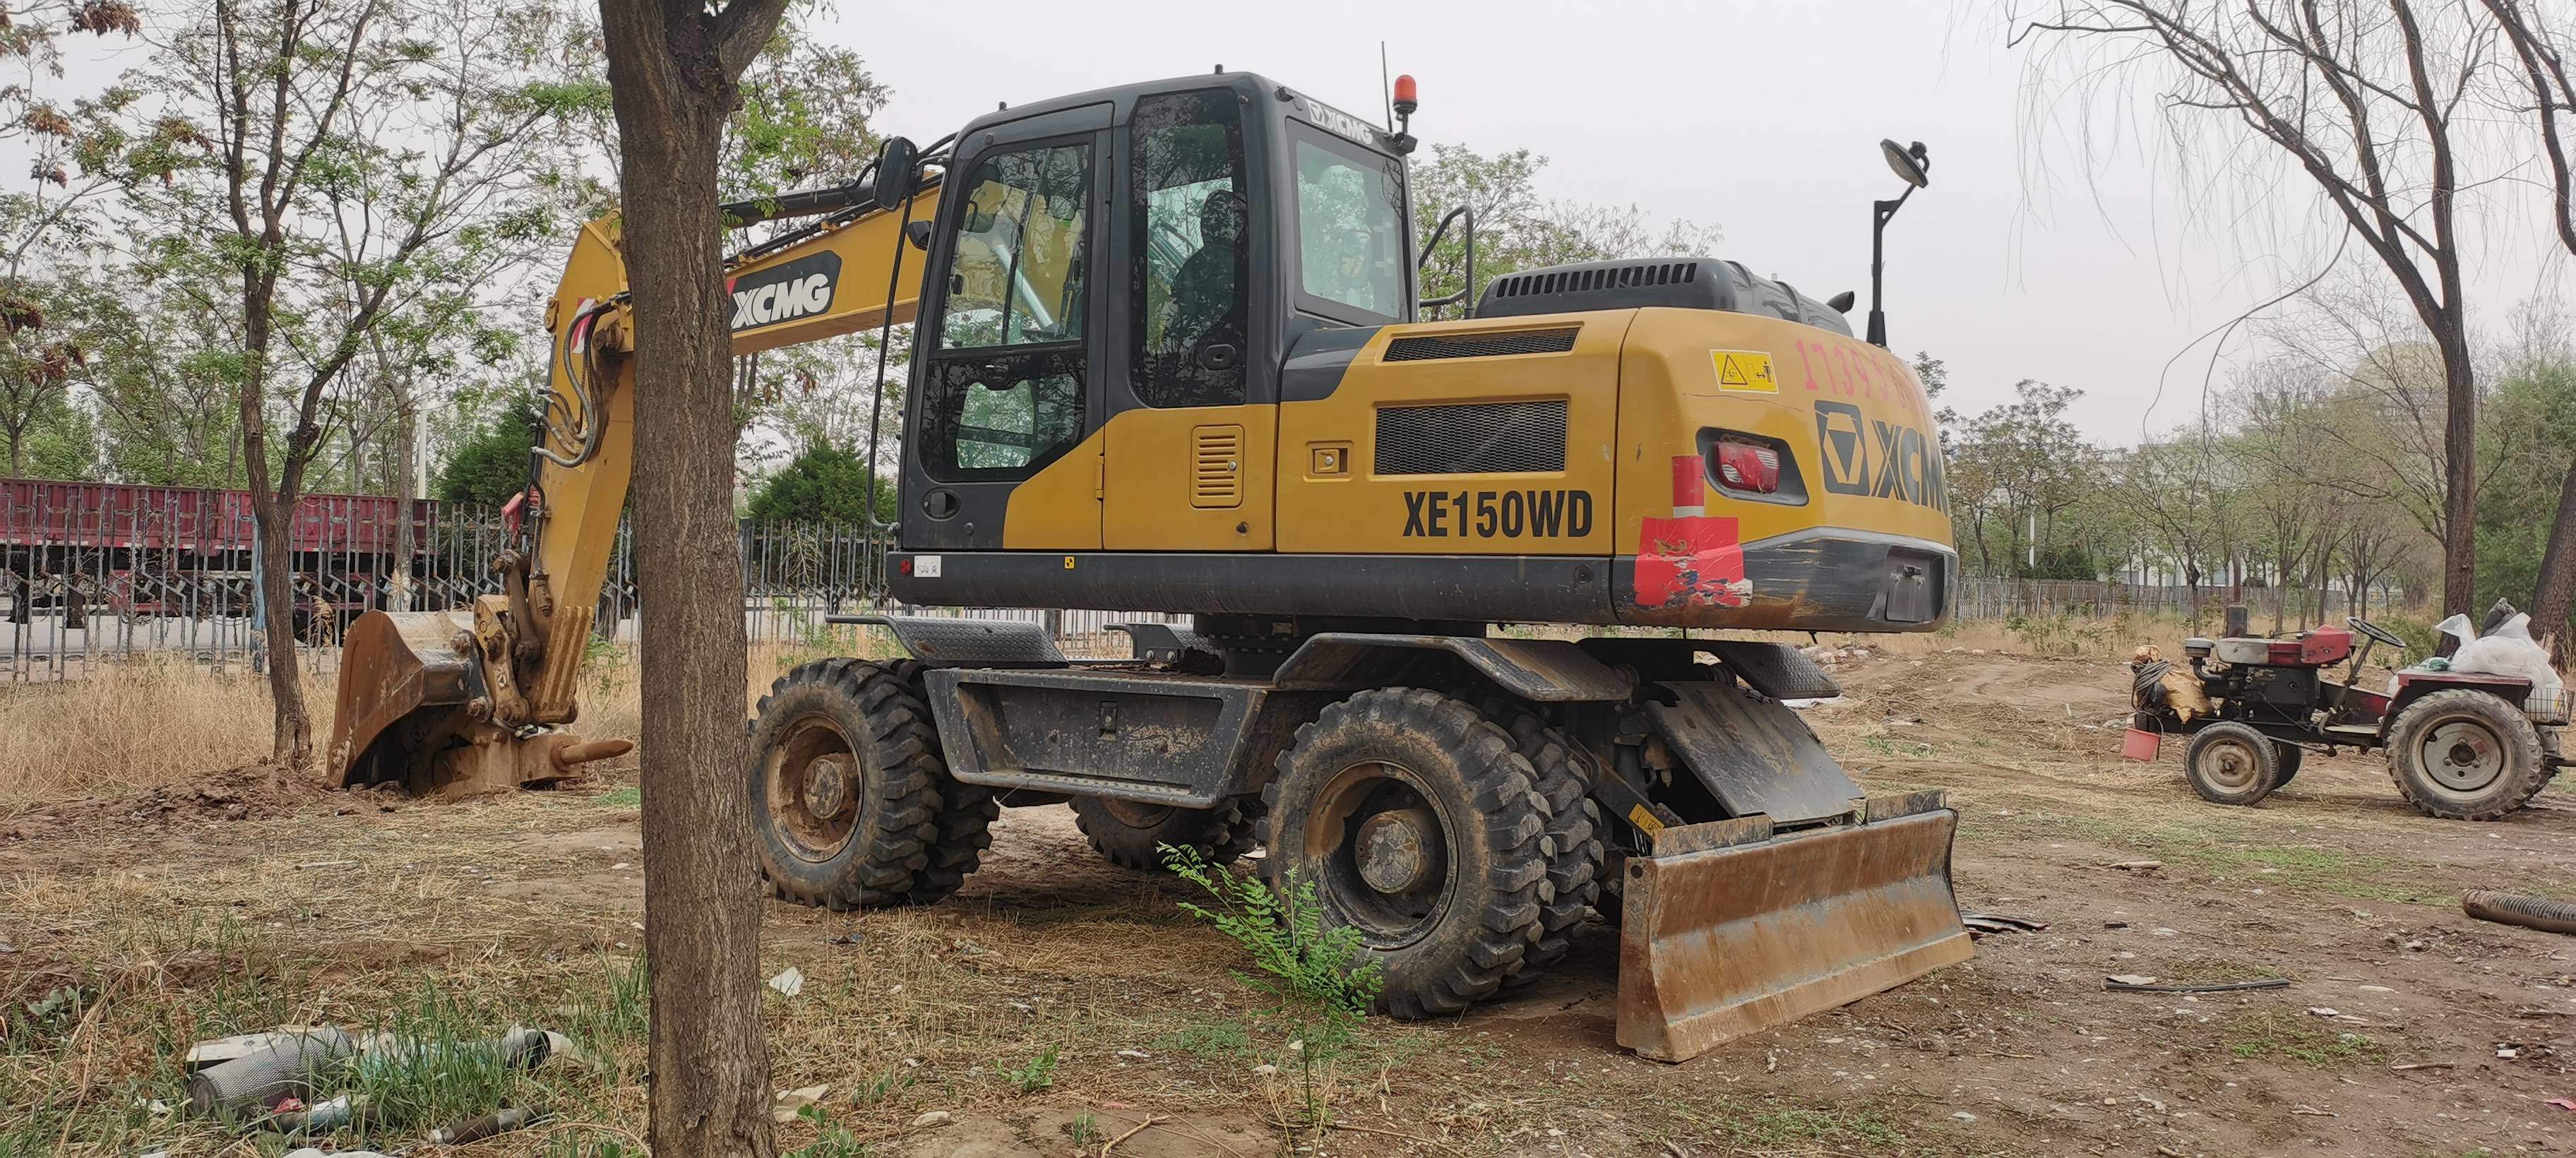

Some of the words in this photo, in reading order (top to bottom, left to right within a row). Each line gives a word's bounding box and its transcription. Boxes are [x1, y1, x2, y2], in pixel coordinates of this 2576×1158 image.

[1323, 108, 1373, 145] XCMG
[731, 273, 830, 330] XCMG
[1871, 418, 1949, 518] XCM
[1402, 490, 1592, 538] XE150WD
